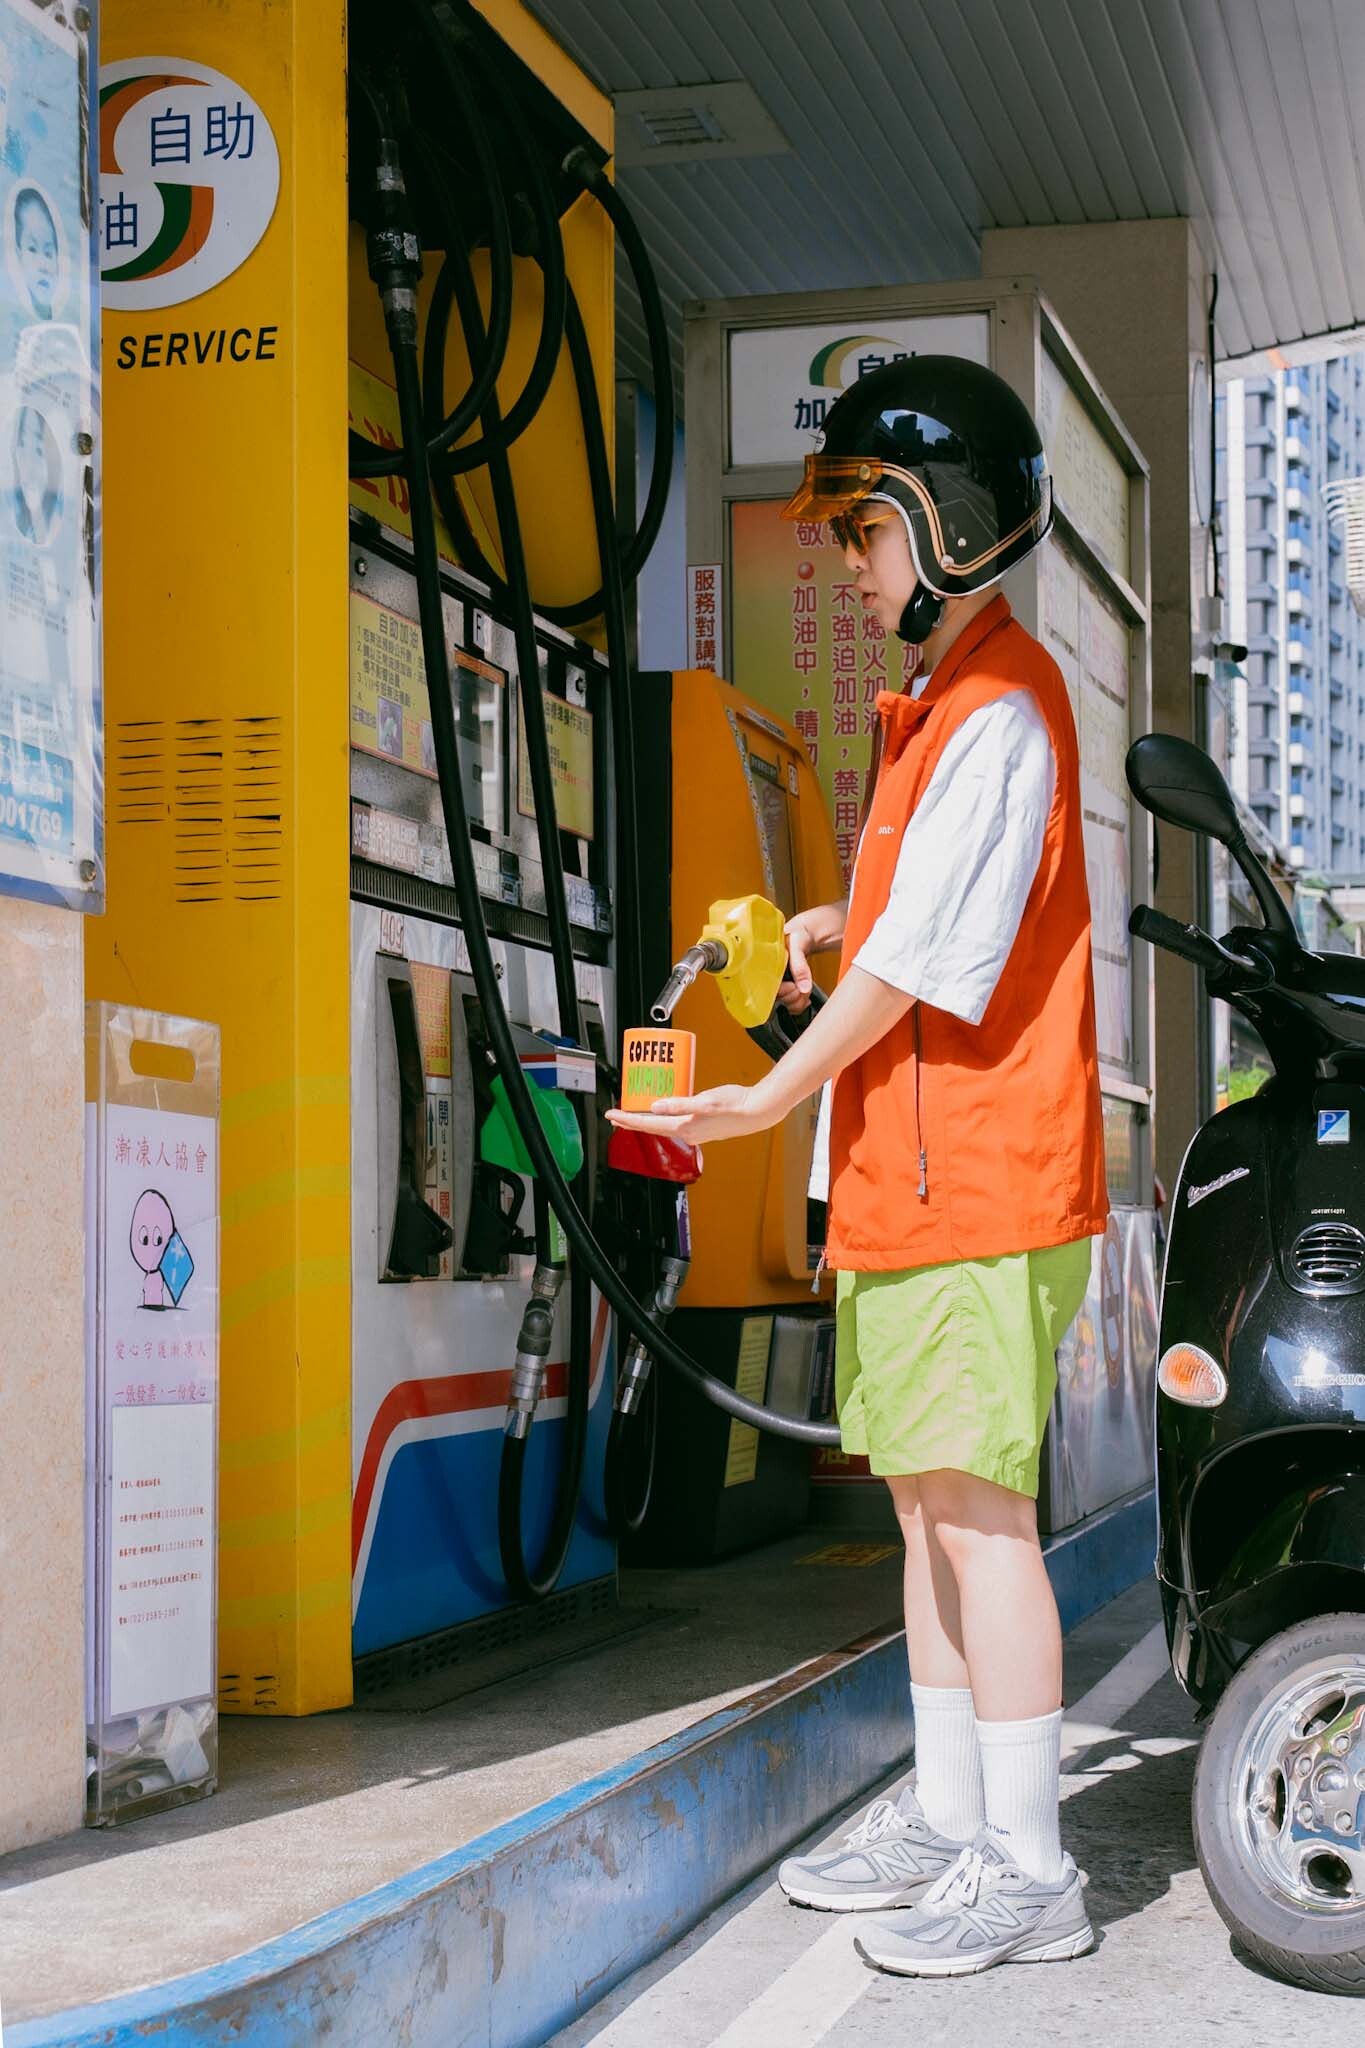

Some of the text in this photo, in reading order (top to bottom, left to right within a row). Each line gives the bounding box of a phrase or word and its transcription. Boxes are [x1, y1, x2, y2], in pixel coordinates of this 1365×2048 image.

[150, 101, 254, 167] 自助
[117, 326, 278, 370] SERVICE
[794, 397, 838, 430] 加
[629, 1040, 675, 1063] COFFEE
[1319, 1112, 1337, 1131] P
